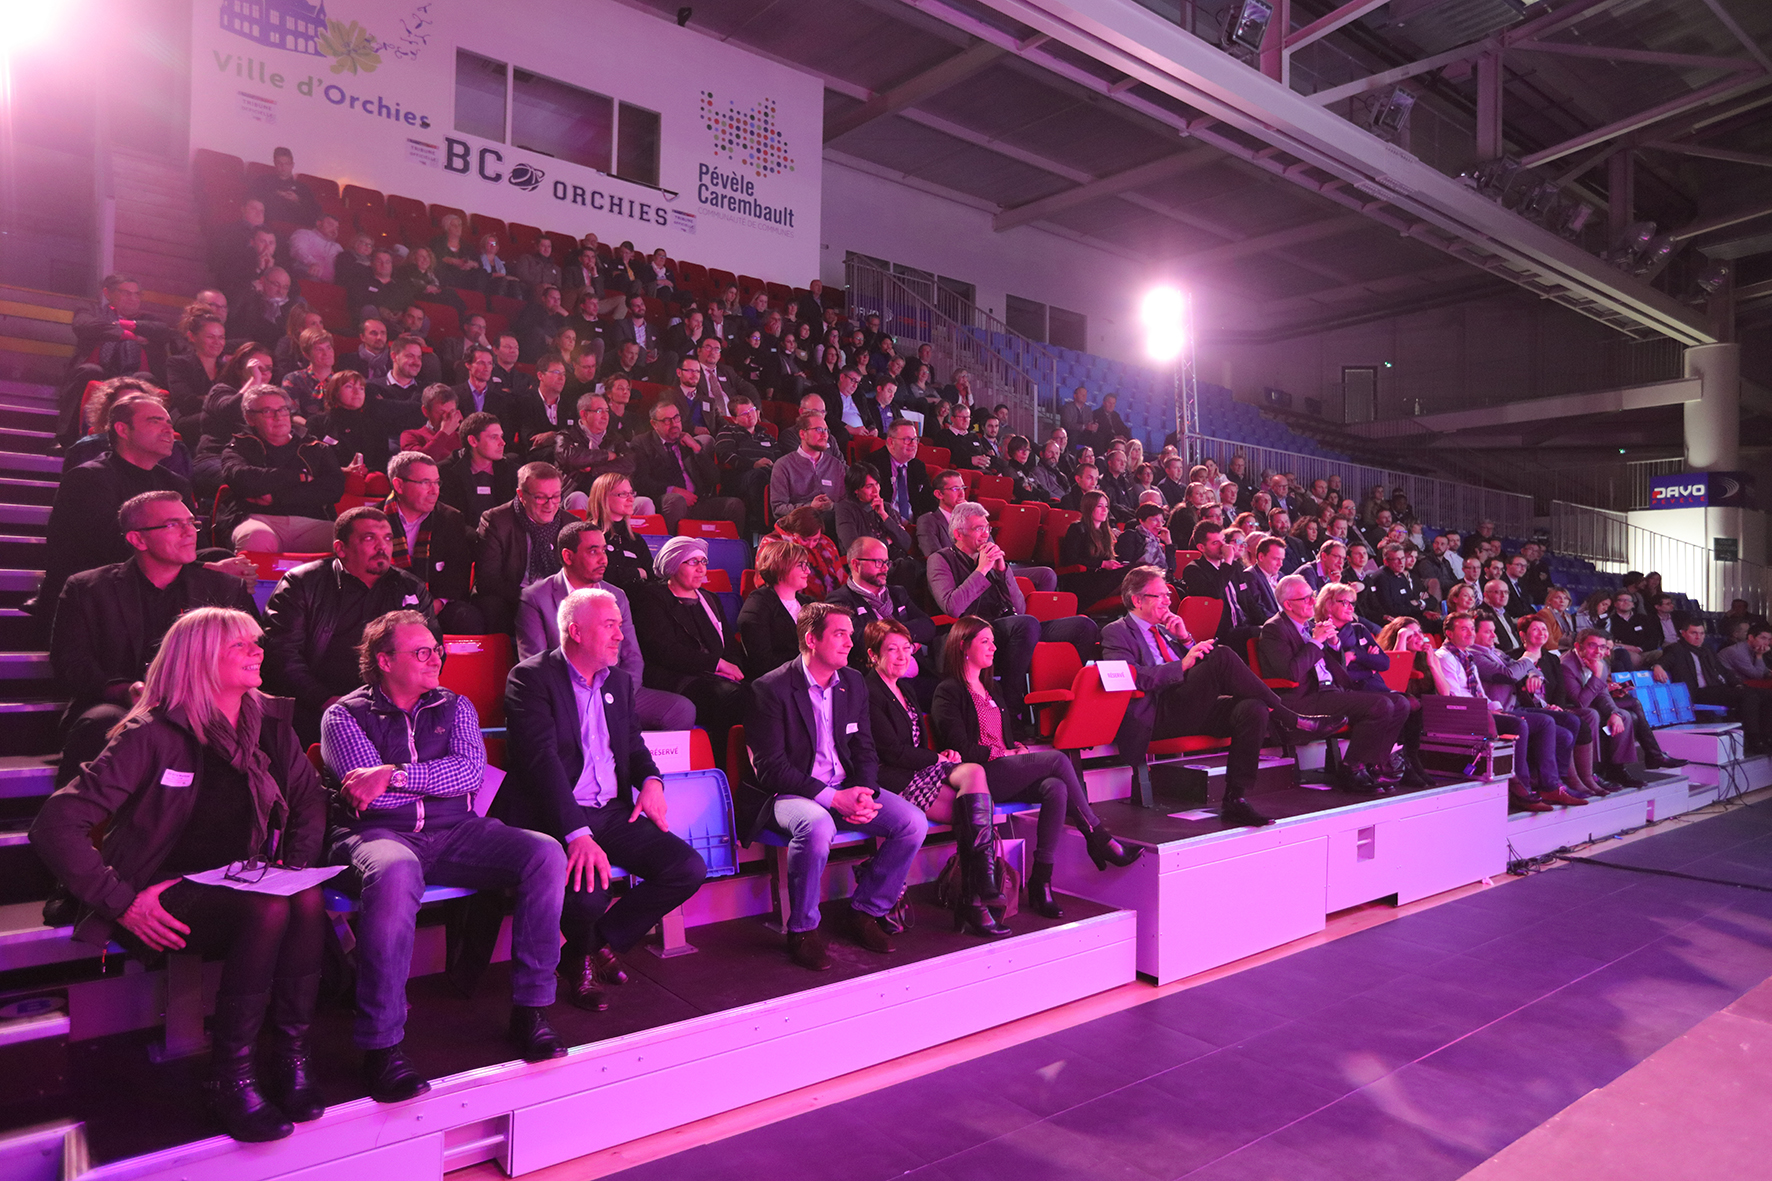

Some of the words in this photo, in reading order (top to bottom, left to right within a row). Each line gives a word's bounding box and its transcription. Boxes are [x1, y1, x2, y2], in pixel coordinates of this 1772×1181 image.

[212, 50, 285, 89] Ville
[297, 76, 431, 130] d'Orchies
[444, 136, 505, 183] BC
[552, 180, 668, 227] ORCHIES
[698, 162, 755, 197] Pévèle
[697, 183, 795, 228] Carembault
[1652, 484, 1705, 499] DAVO
[650, 746, 678, 756] RÉSERVÉ
